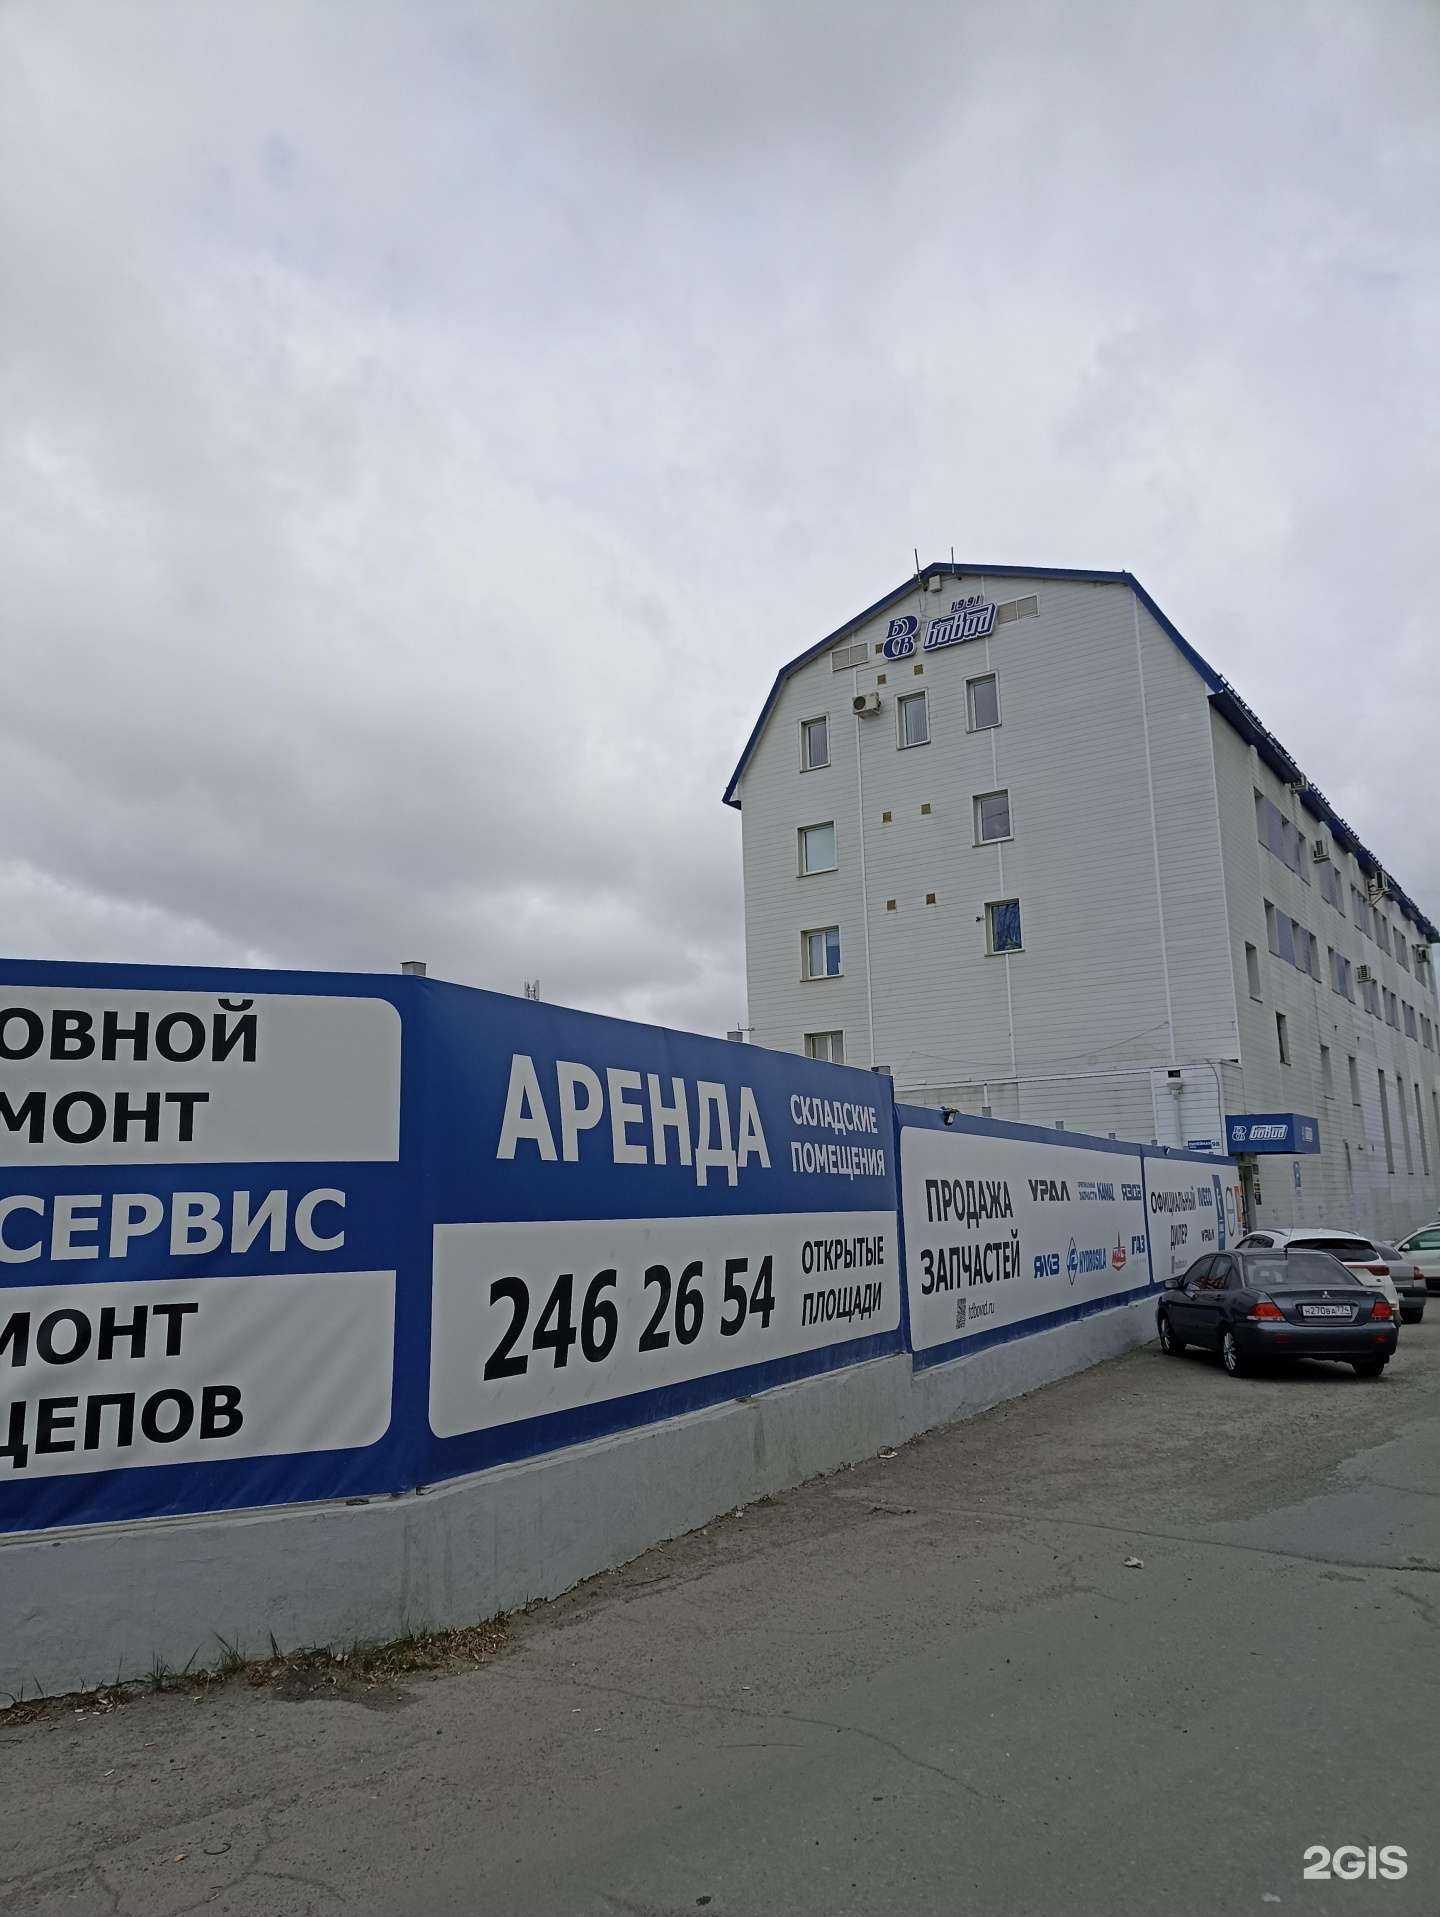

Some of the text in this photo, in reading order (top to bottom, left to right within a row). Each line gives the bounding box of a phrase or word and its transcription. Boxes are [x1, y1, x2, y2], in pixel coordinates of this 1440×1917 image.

[0, 998, 257, 1063] ОВНОЙ
[496, 1053, 771, 1187] АРЕНДА
[790, 1094, 878, 1135] СКЛАДСКИЕ
[791, 1141, 885, 1180] ПОМЕЩЕНИЯ
[925, 1179, 1013, 1229] ПРОДАЖА
[1028, 1179, 1071, 1201] УРАЛ
[1151, 1186, 1196, 1217] ОФИЦИАЛЬНЫЙ
[0, 1188, 346, 1264] СЕРВИС
[1132, 1234, 1145, 1255] ГАЗ
[1170, 1223, 1187, 1251] ДИЛЕР
[802, 1236, 884, 1274] ОТКРЫТЫЕ
[920, 1229, 1020, 1295] ЗАПЧАСТЕЙ
[483, 1255, 775, 1382] 246 26 54
[801, 1282, 882, 1327] ПЛОЩАДИ
